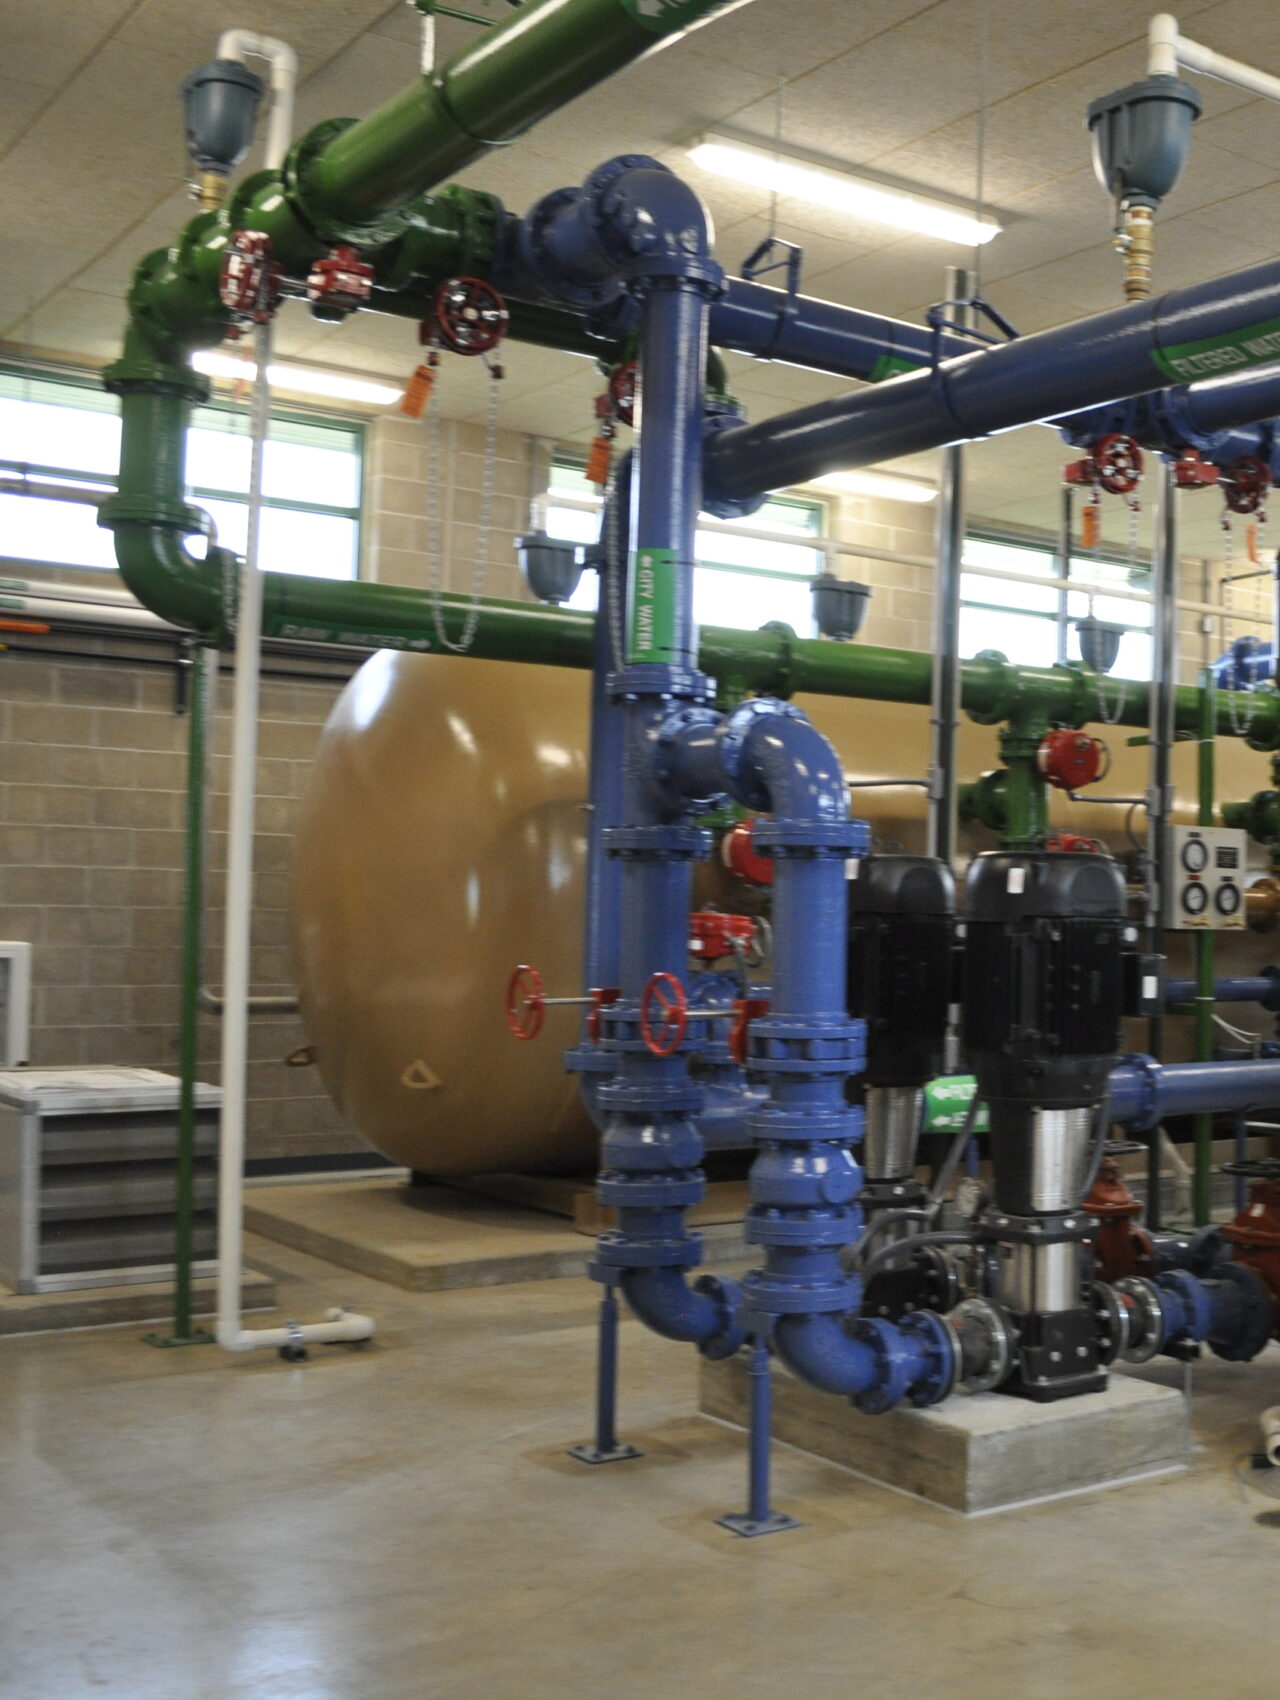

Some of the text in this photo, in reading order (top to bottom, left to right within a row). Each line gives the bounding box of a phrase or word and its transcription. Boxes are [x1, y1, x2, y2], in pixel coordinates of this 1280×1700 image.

[1170, 347, 1247, 376] FILTERED
[637, 569, 655, 650] CITY WATER
